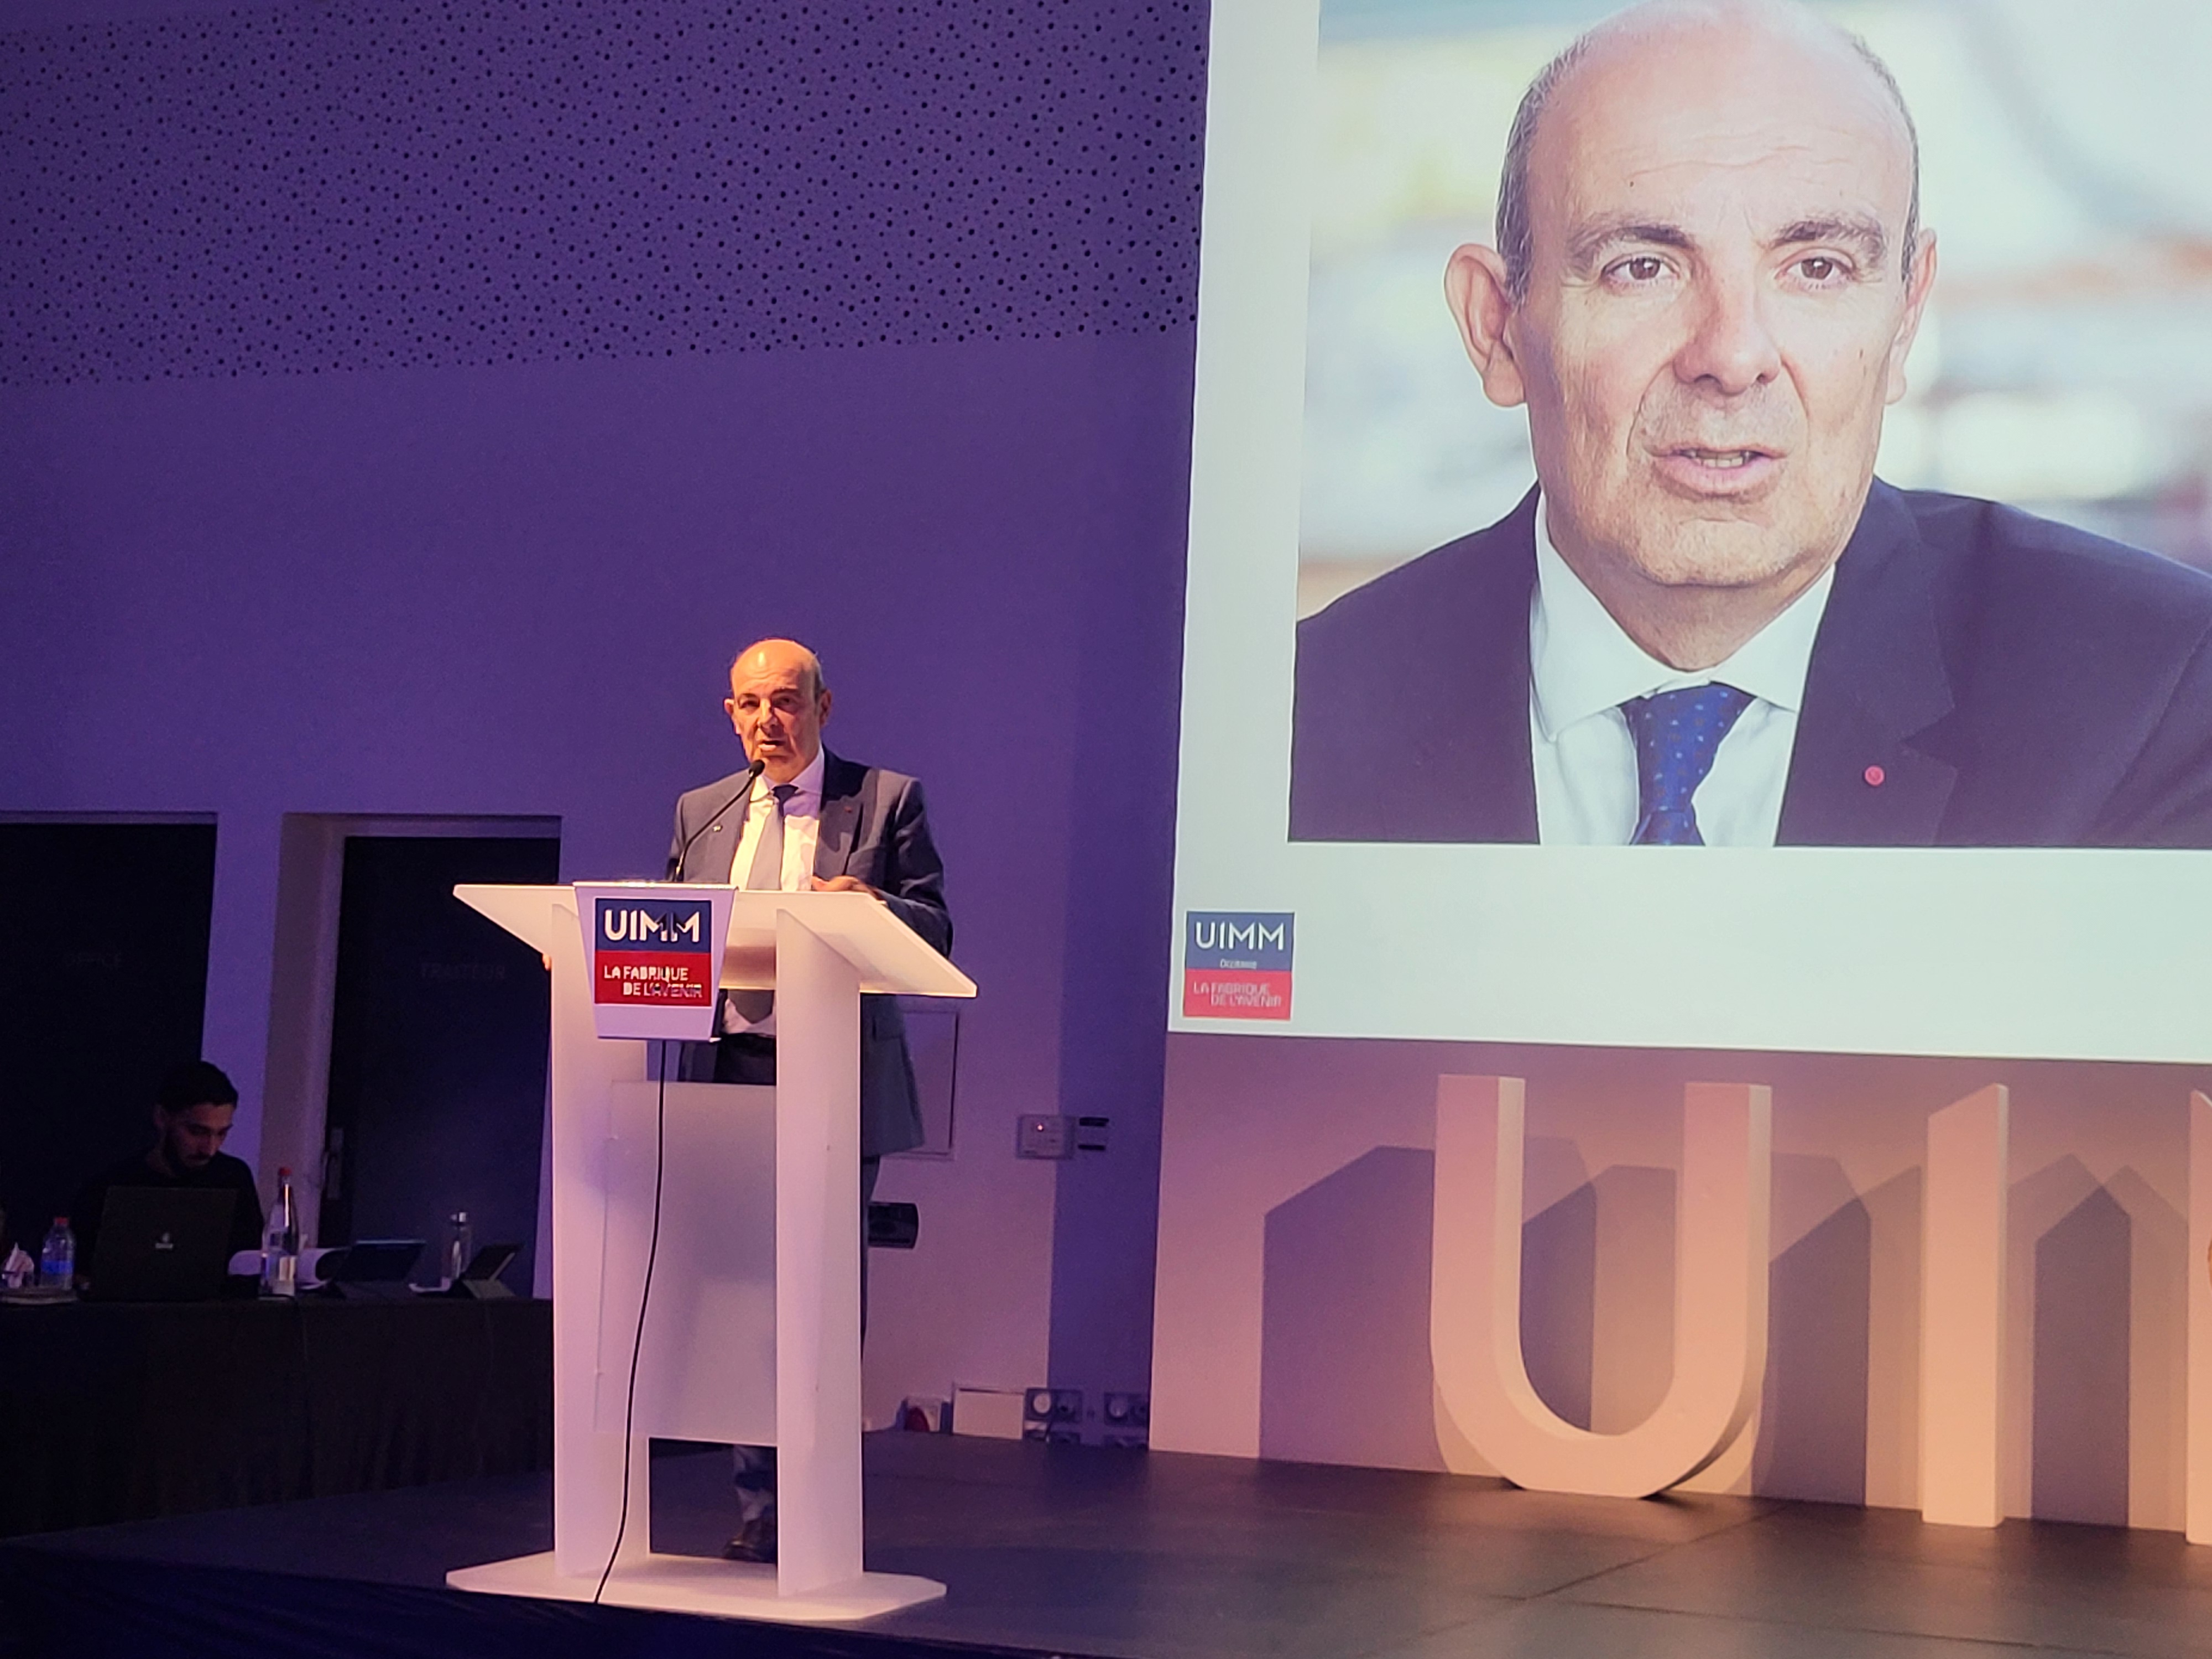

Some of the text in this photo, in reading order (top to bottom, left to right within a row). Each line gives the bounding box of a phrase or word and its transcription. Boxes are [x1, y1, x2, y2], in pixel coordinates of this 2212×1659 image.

[604, 909, 700, 942] UIMM
[1196, 921, 1284, 951] UIMM
[604, 965, 688, 983] LA FABRIQUE
[623, 982, 703, 998] DE L'AVENIR
[1193, 981, 1270, 995] LA FABRIQUE
[1211, 994, 1226, 1006] DE
[1431, 1073, 2212, 1544] UI
